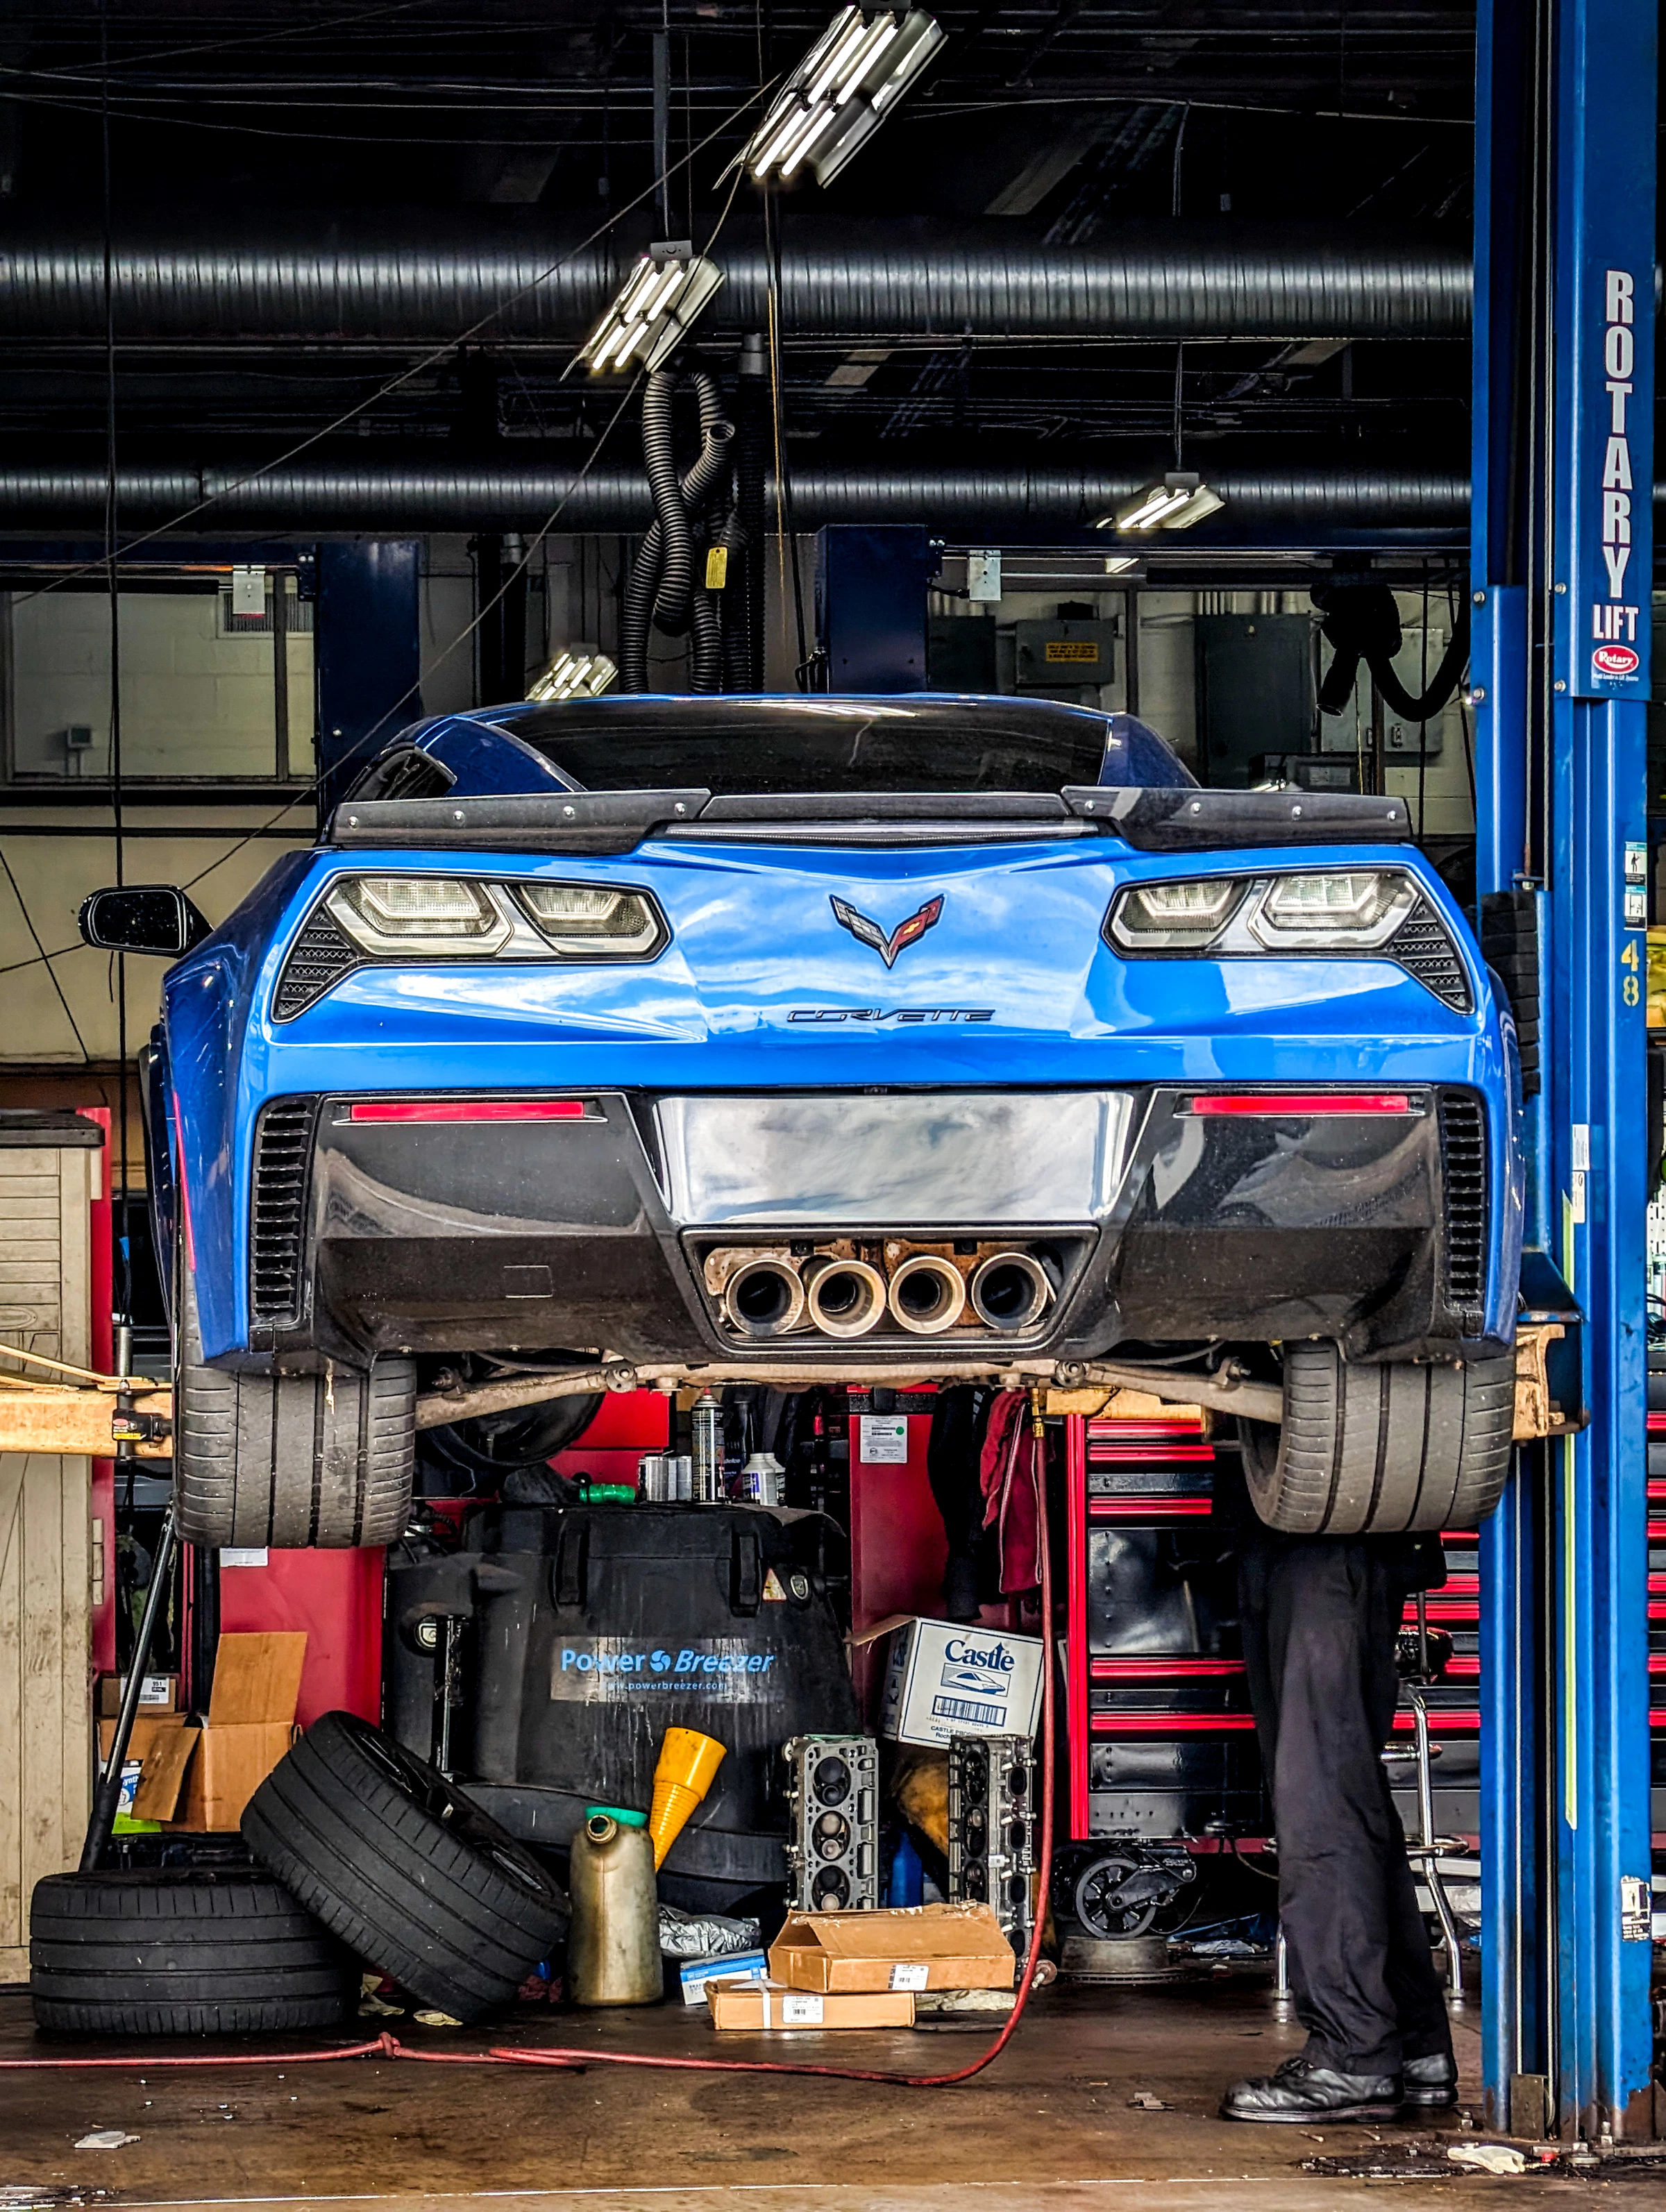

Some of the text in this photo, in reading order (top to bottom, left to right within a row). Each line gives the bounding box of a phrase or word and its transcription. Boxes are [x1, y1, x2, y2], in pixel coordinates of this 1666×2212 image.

[1602, 270, 1633, 598] ROTARY
[1593, 605, 1639, 641] LIFT
[1599, 651, 1633, 668] Rotary
[787, 1008, 995, 1022] CORVETTE
[561, 1648, 775, 1673] Power Breezer
[945, 1639, 1015, 1671] Castle
[931, 1725, 954, 1734] CASTLE
